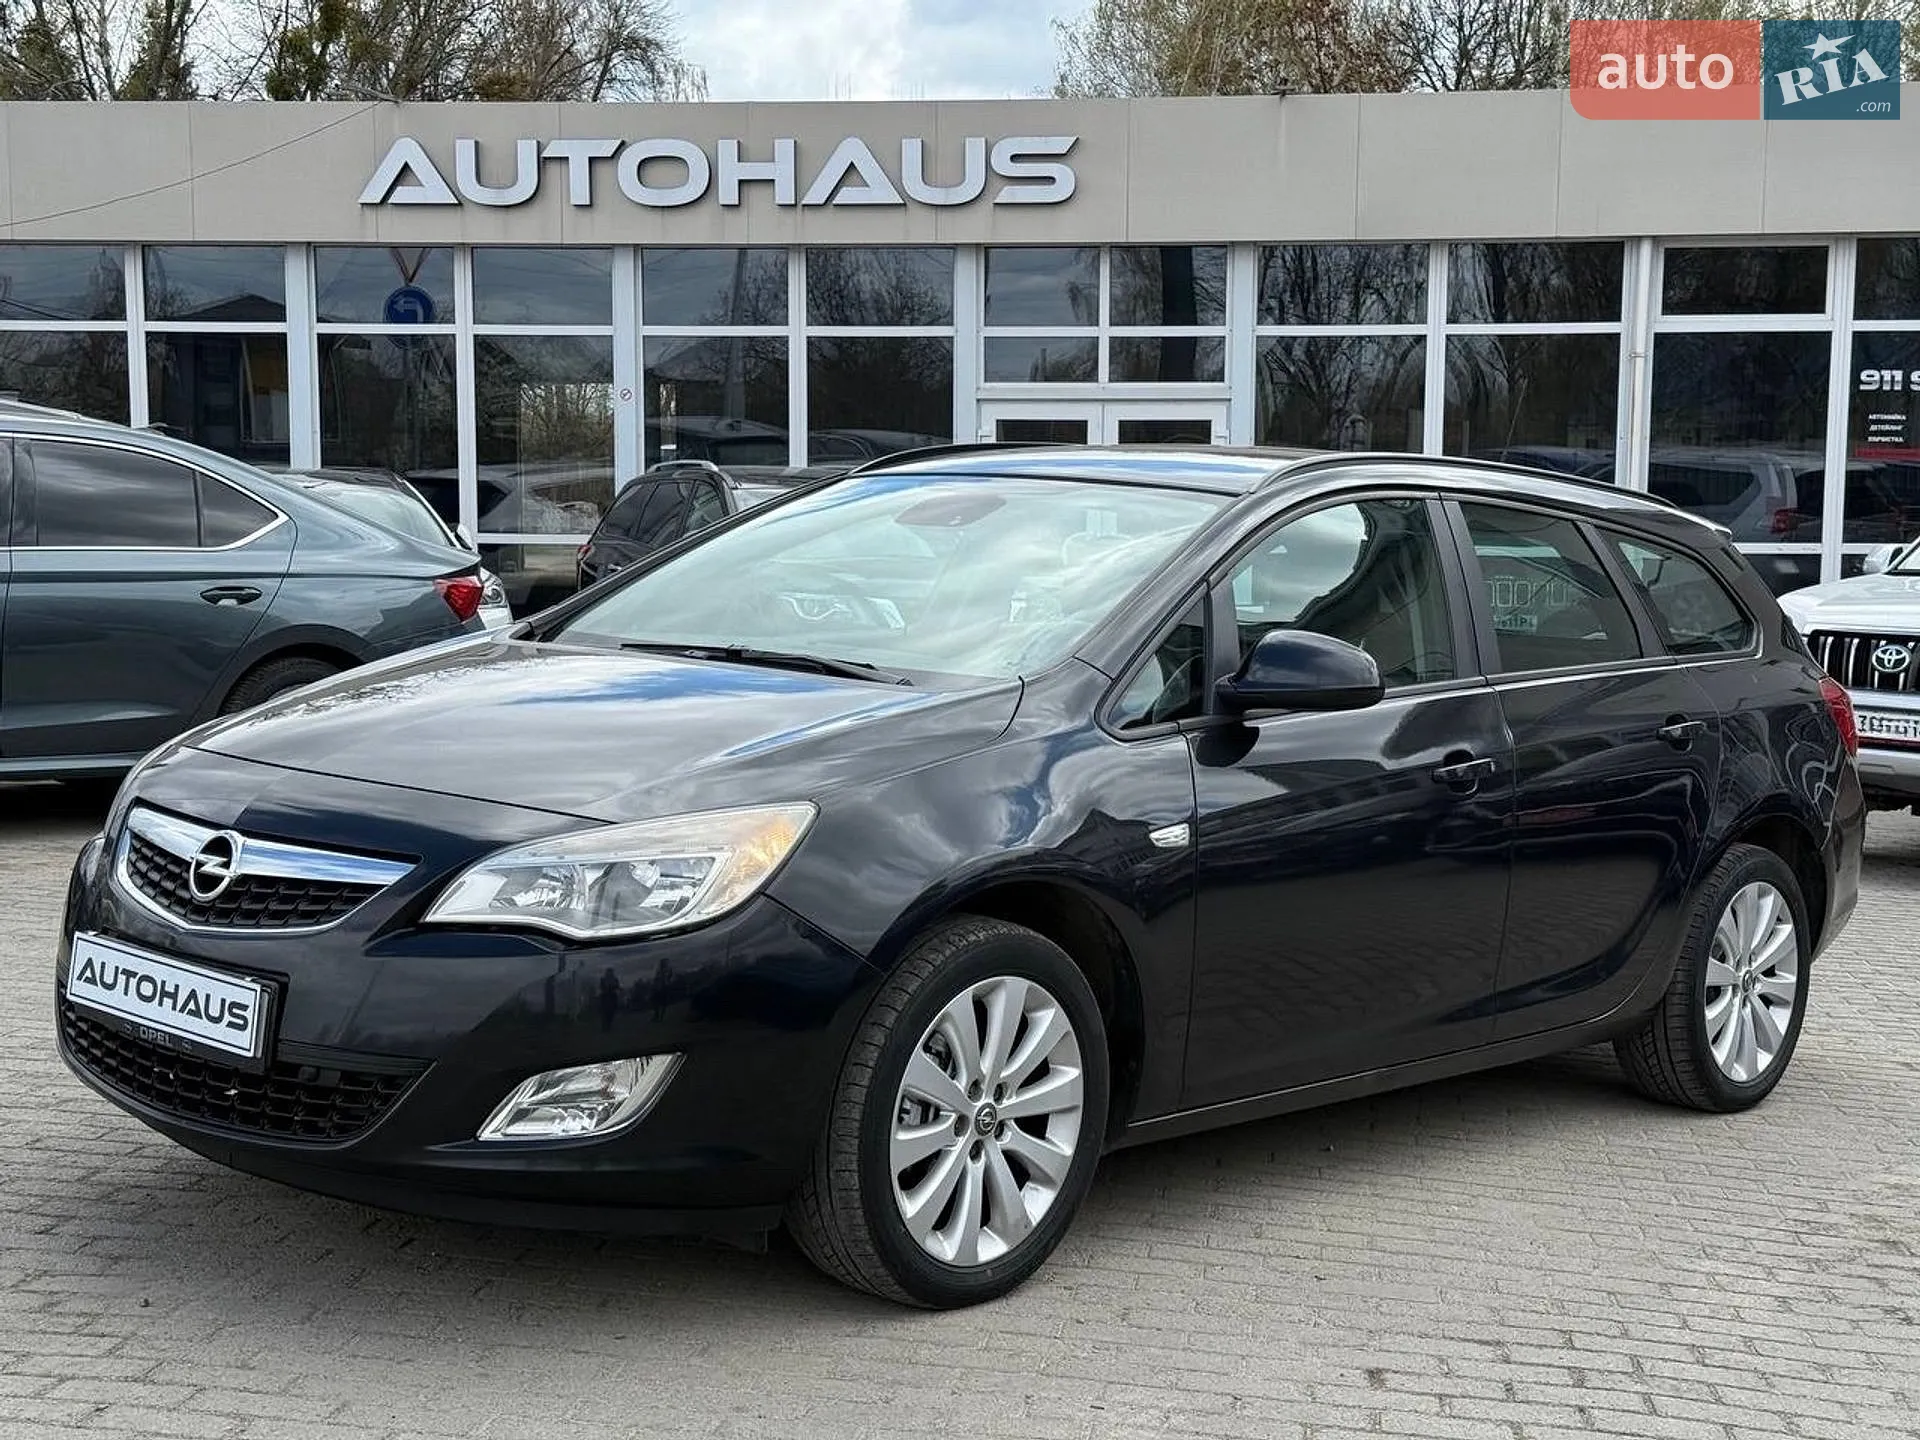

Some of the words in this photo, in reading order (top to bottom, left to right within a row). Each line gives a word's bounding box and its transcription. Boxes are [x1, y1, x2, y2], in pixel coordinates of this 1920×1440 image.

[358, 136, 1080, 207] AUTOHAUS
[1859, 369, 1903, 390] 911
[76, 957, 250, 1032] AUTOHAUS
